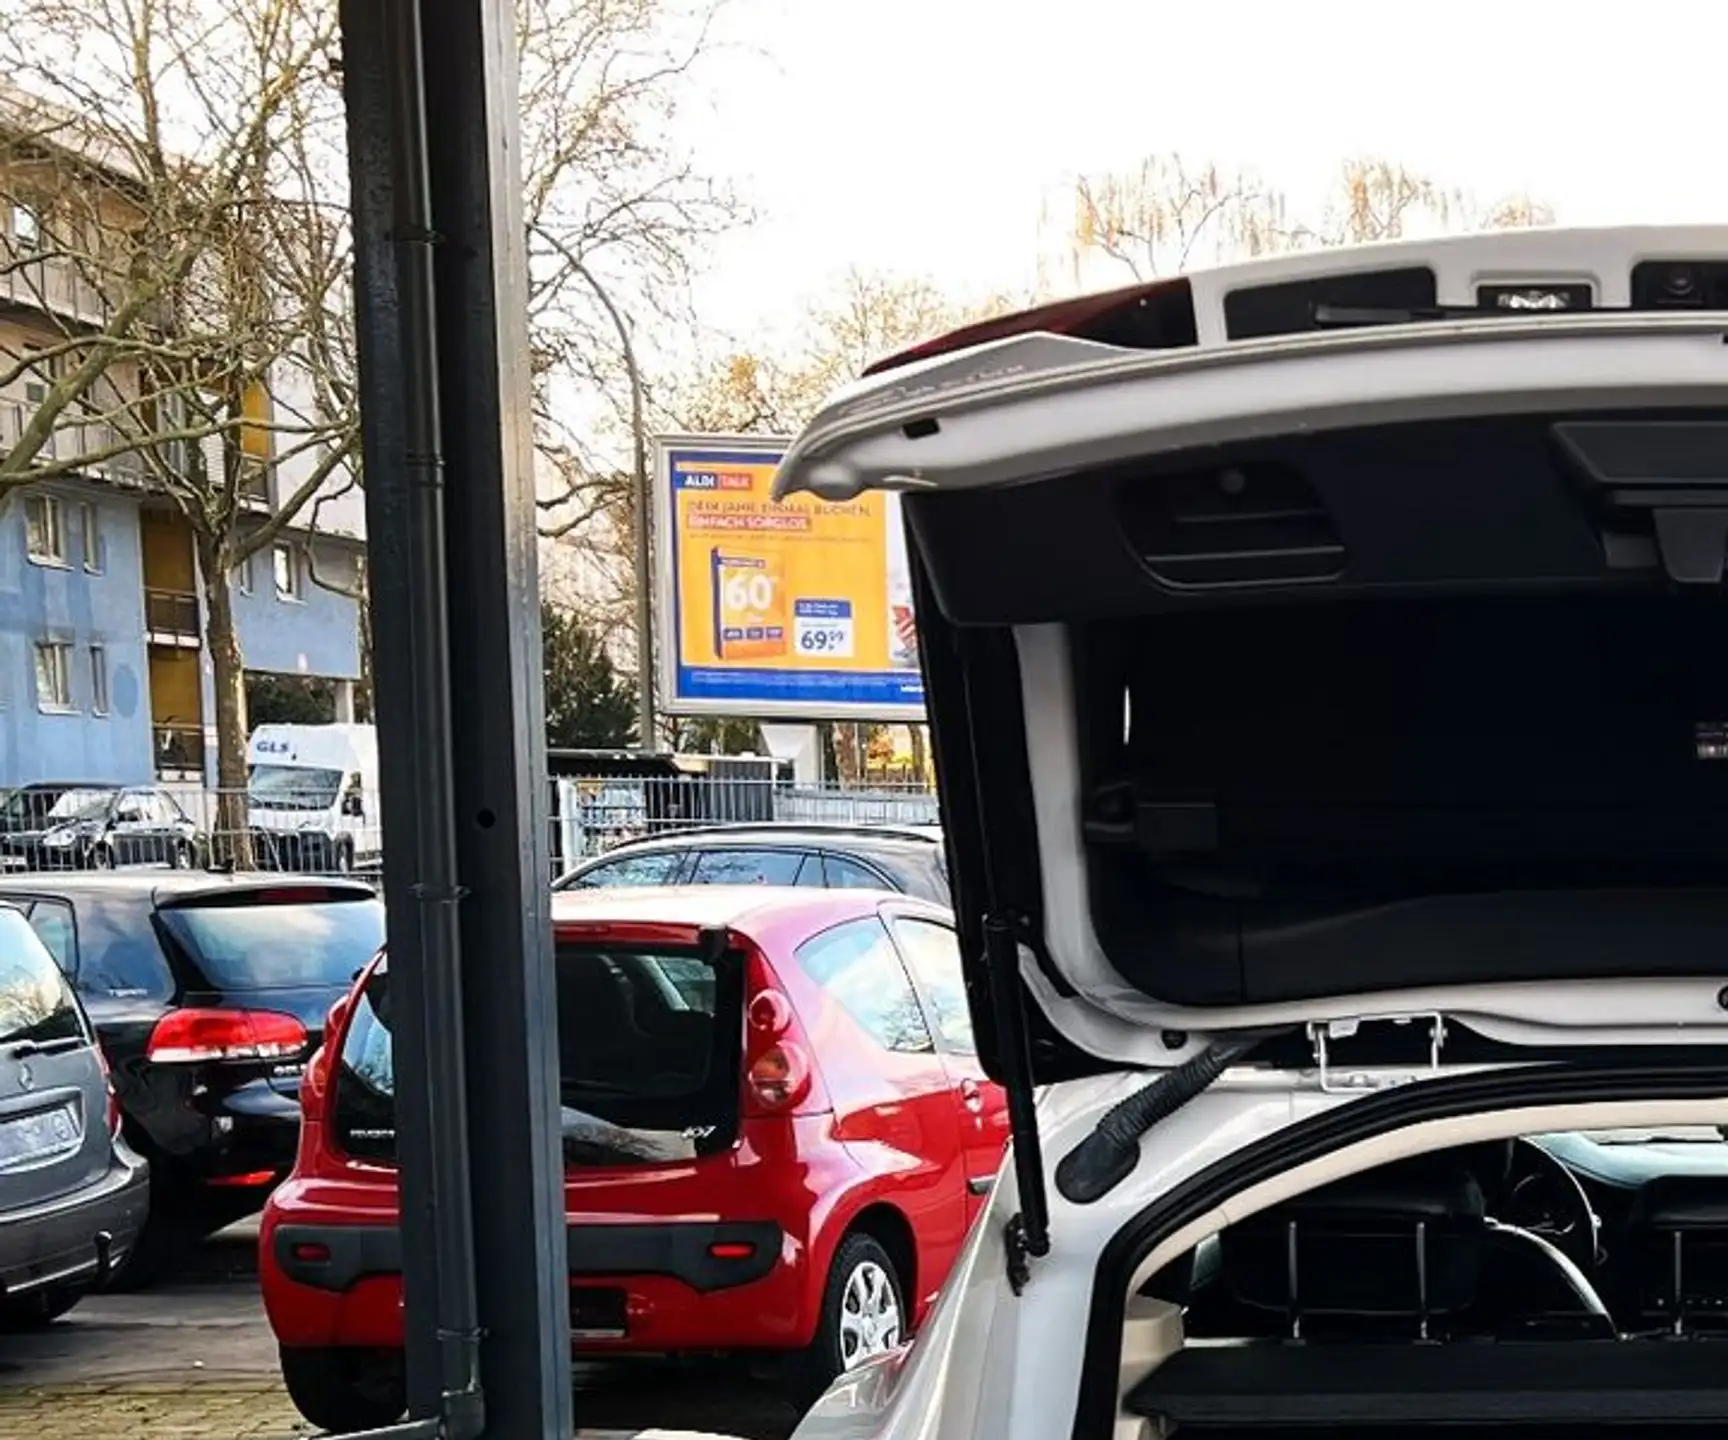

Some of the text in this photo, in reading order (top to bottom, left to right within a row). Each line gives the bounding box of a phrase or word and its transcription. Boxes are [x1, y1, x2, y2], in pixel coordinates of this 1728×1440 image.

[684, 475, 715, 488] ALDI
[727, 573, 771, 611] 60
[256, 740, 289, 753] GLS
